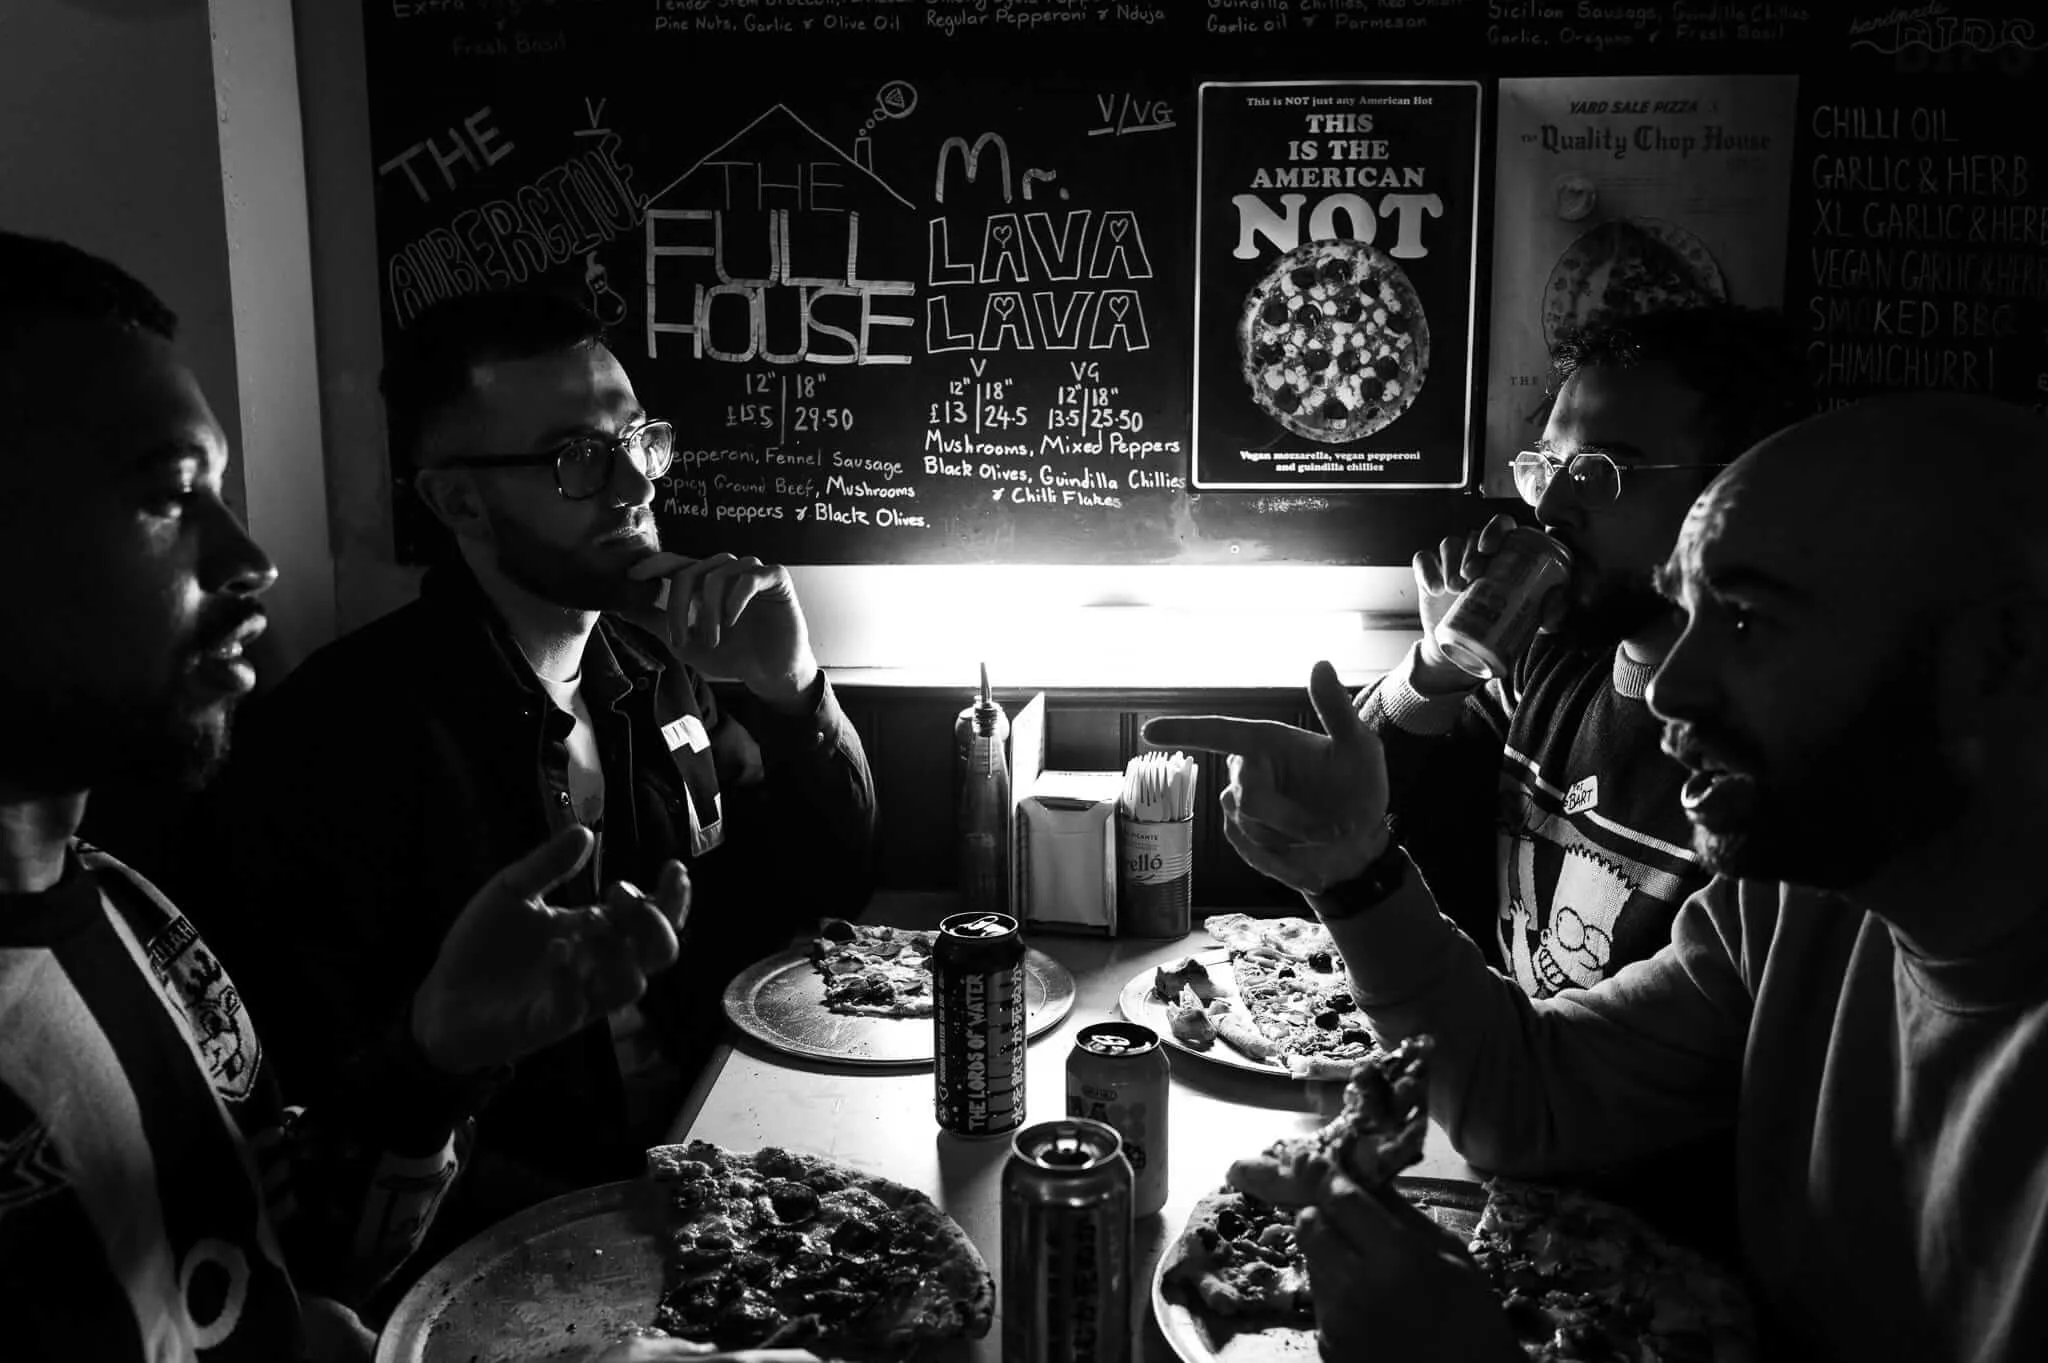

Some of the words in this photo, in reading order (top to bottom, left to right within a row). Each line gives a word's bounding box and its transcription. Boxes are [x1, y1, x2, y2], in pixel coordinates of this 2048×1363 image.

[655, 15, 689, 32] Pine
[744, 12, 793, 33] Garlic
[823, 14, 867, 31] Olive
[873, 15, 901, 32] Oil
[927, 9, 989, 38] Regular
[995, 6, 1087, 31] Pepperoni
[1116, 5, 1166, 25] Nduja
[1207, 13, 1258, 33] Garlic
[1264, 13, 1289, 32] oil
[1334, 13, 1428, 32] Parmesan
[1488, 0, 1565, 20] Sicilian
[585, 96, 607, 130] V
[1247, 97, 1270, 106] This
[1273, 97, 1282, 106] is
[1285, 96, 1310, 105] NOT
[1312, 96, 1333, 107] just
[1336, 98, 1356, 107] any
[1359, 96, 1410, 105] American
[1413, 96, 1433, 105] Hot
[1570, 101, 1609, 114] YARD
[1611, 101, 1650, 114] SALE
[1653, 101, 1698, 114] PIZZA
[1305, 113, 1374, 133] THIS
[1811, 104, 1900, 140] CHILLI
[1911, 106, 1962, 144] OIL
[378, 105, 516, 204] THE
[1288, 140, 1318, 161] IS
[1328, 140, 1390, 160] THE
[1541, 124, 1627, 159] Quality
[1633, 125, 1696, 158] Chop
[1702, 125, 1772, 152] House
[936, 131, 1070, 205] Mr.
[1250, 167, 1425, 188] AMERICAN
[1811, 153, 1912, 192] GARLIC
[1948, 154, 2029, 197] HERB
[704, 161, 846, 213] THE
[1232, 192, 1444, 260] NOT
[1812, 199, 1852, 238] XL
[1863, 201, 1964, 242] GARLIC
[646, 208, 917, 289] FULL
[929, 209, 1153, 286] LAVA
[1811, 246, 1894, 290] VEGAN
[648, 277, 916, 366] HOUSE
[926, 289, 1150, 353] LAVA
[1809, 295, 1940, 339] SMOKED
[1952, 300, 2017, 339] BBQ
[968, 357, 988, 378] V
[1071, 361, 1101, 383] VG
[1806, 341, 1996, 393] CHIMICHURRI
[794, 406, 854, 432] 29.50
[929, 400, 968, 425] £13
[984, 404, 1029, 431] 24.5
[1090, 407, 1144, 432] 25.50
[925, 429, 1035, 457] Mushrooms,
[1040, 430, 1103, 456] Mixed
[1109, 433, 1181, 461] Peppers
[1239, 450, 1272, 462] Vegan
[1273, 451, 1333, 461] mozzarella,
[1335, 452, 1365, 462] vegan
[1367, 450, 1421, 462] pepperoni
[672, 449, 760, 476] epperoni,
[764, 447, 823, 467] Fennel
[832, 449, 905, 477] Sausage
[924, 456, 974, 478] Black
[979, 461, 1033, 485] Olives,
[1040, 466, 1119, 490] Guindilla
[1129, 469, 1187, 492] Chillies
[1275, 463, 1296, 472] and
[1298, 463, 1345, 473] guindilla
[1347, 463, 1384, 472] chillies
[713, 473, 767, 494] Ground
[826, 475, 916, 498] Mushrooms
[1011, 487, 1057, 504] Chilli
[1062, 490, 1122, 509] Flakes
[664, 496, 709, 518] Mixed
[715, 505, 784, 524] peppers
[814, 502, 871, 526] Black
[1126, 853, 1163, 872] relló
[965, 972, 987, 1027] WATER
[964, 1028, 987, 1051] OF
[966, 1051, 987, 1099] LORDS
[967, 1099, 988, 1131] THE
